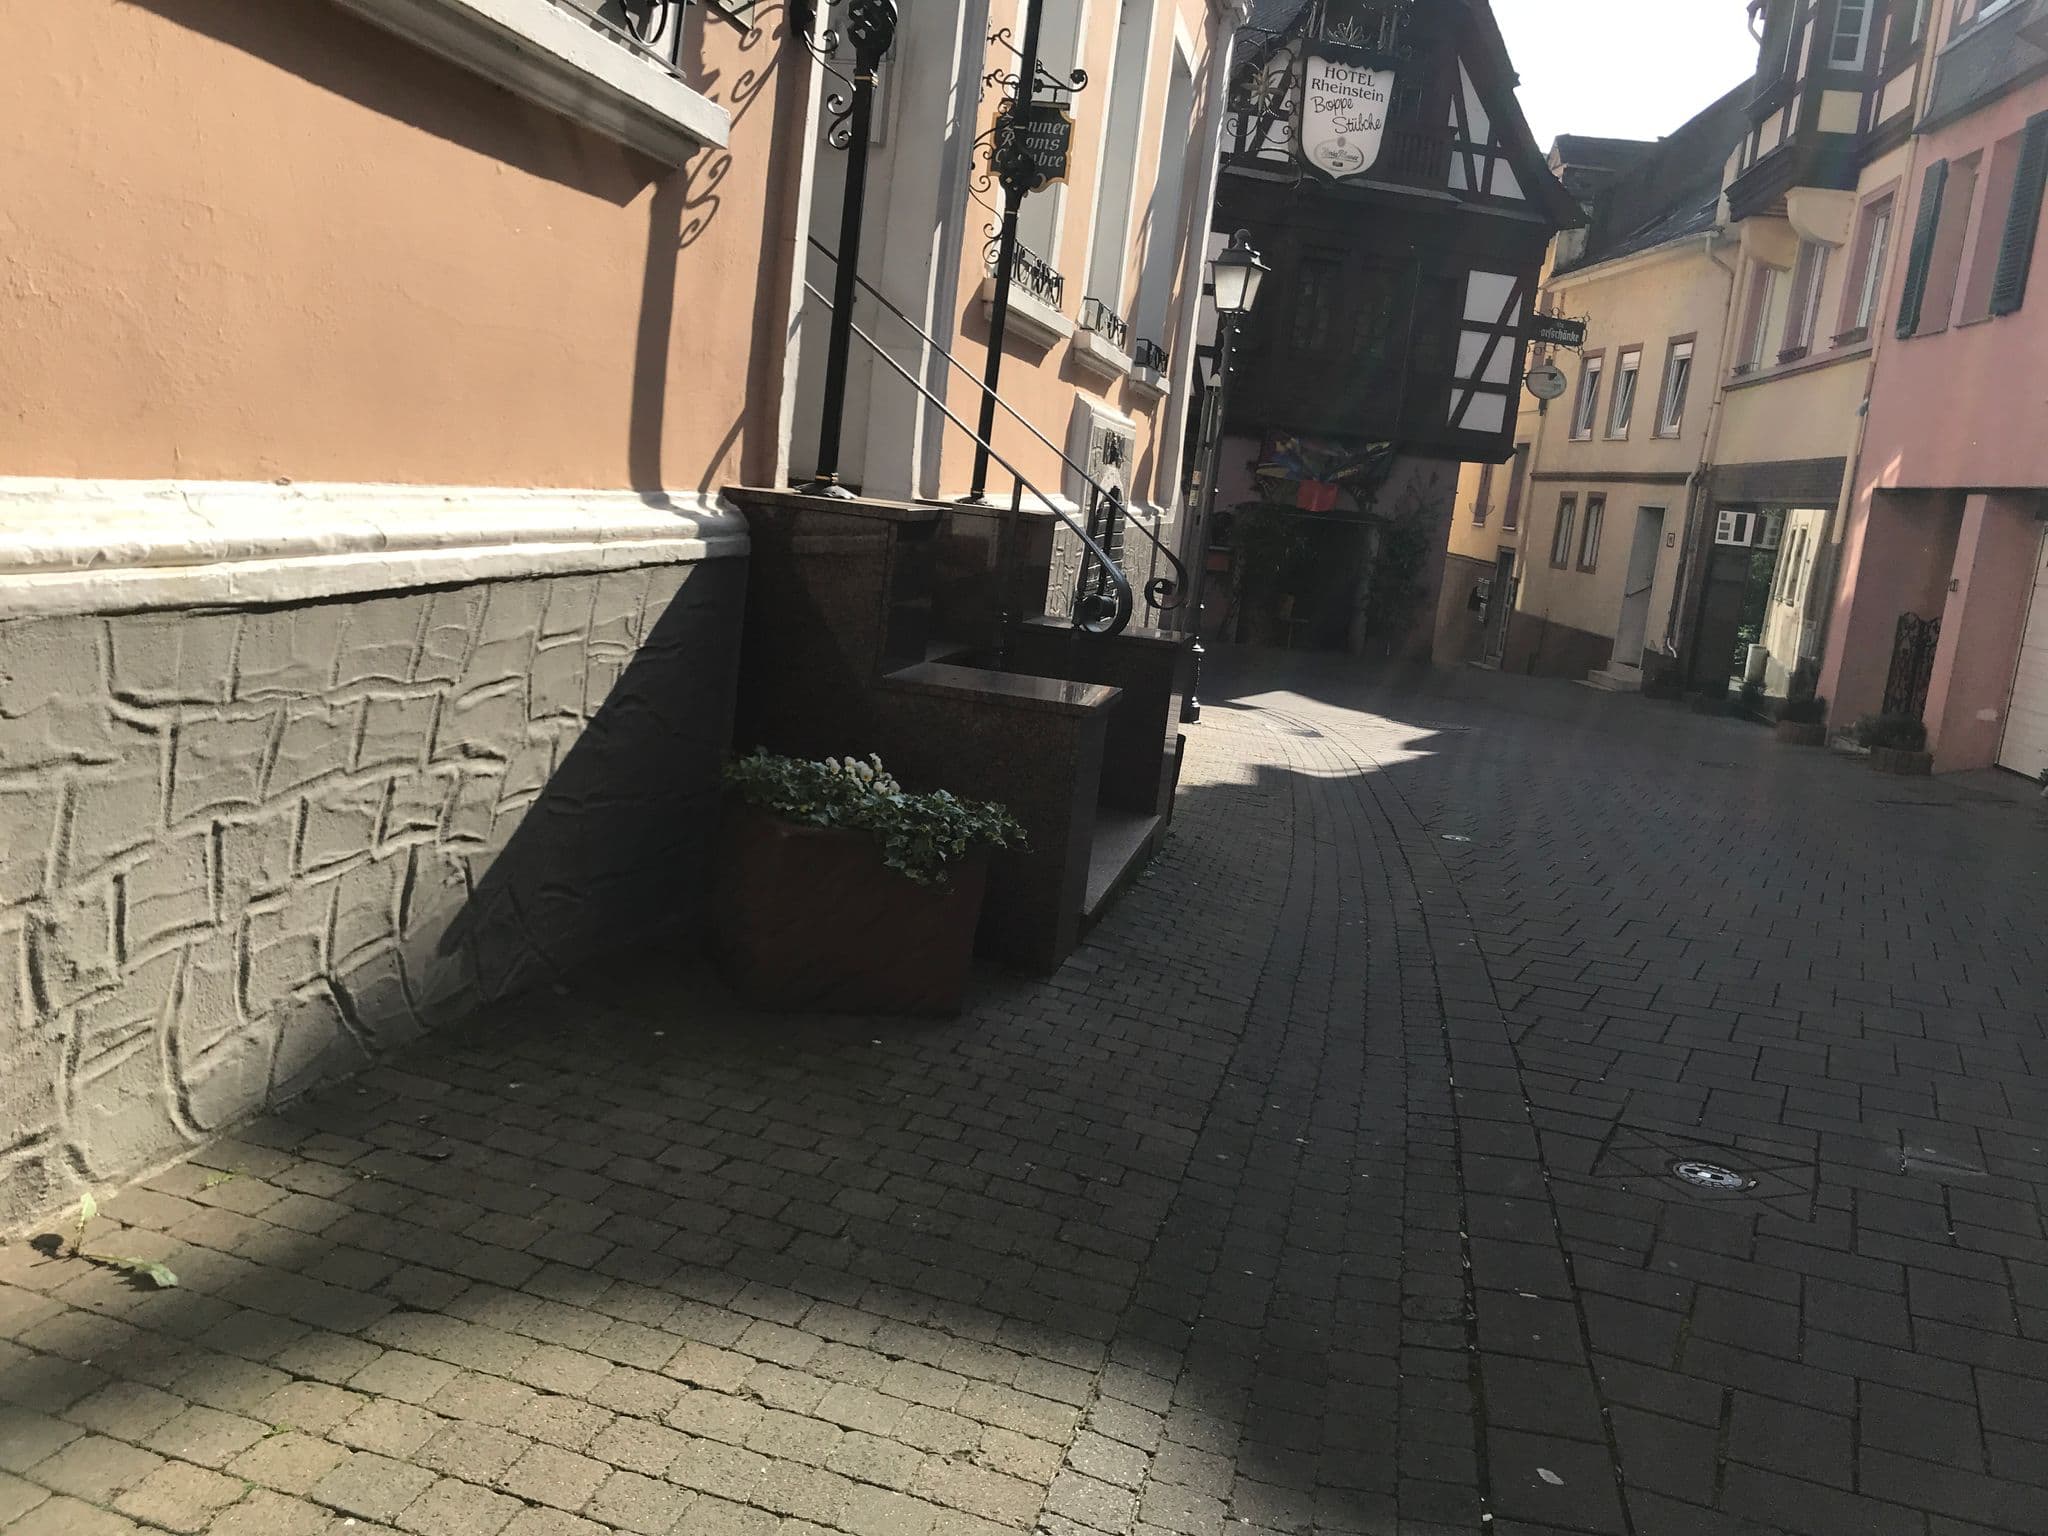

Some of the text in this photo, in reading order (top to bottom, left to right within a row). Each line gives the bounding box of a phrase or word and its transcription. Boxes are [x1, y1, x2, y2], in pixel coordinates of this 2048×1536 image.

[1324, 66, 1375, 87] HOTEL
[1311, 78, 1384, 102] Rheinstein
[1310, 96, 1354, 115] Boppe
[1332, 113, 1381, 134] Stübche
[1001, 130, 1061, 151] Roms
